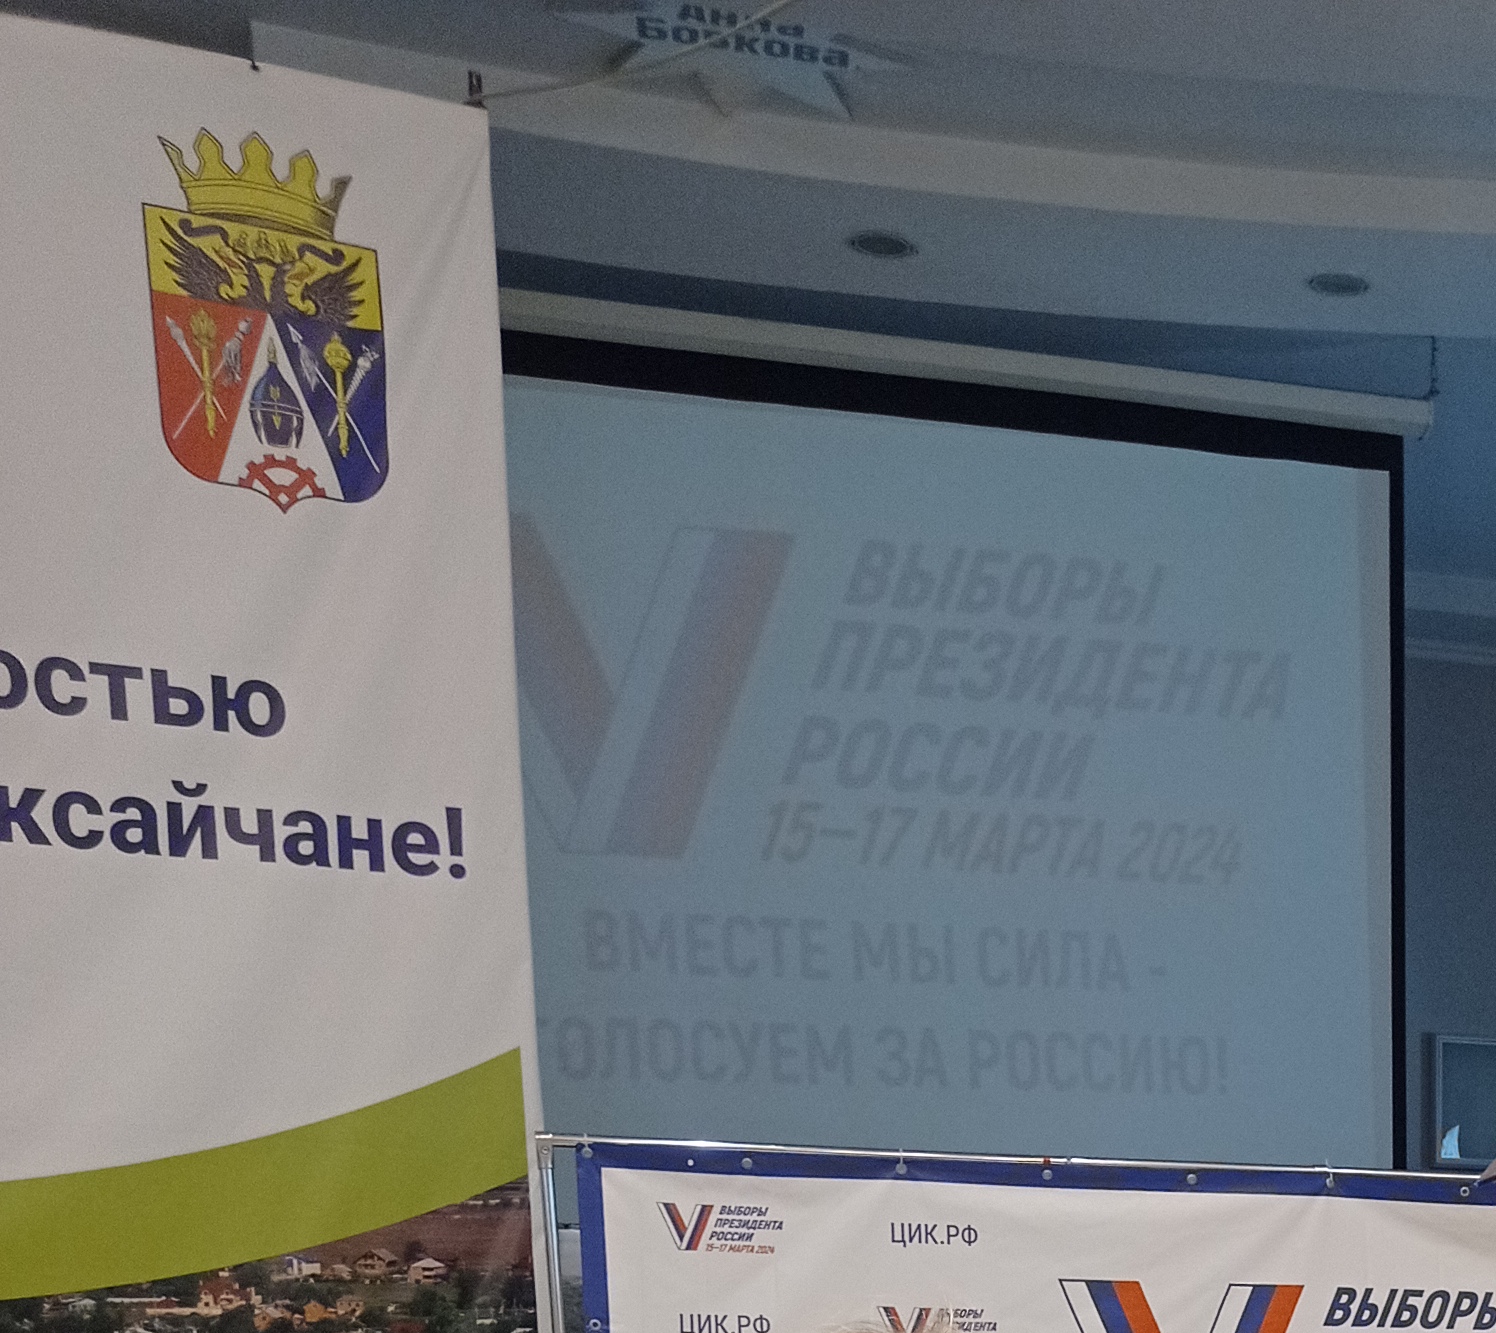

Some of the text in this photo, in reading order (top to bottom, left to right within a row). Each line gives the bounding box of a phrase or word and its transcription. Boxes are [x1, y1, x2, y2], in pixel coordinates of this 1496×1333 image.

[843, 540, 1165, 627] ВЫБОРЫ
[811, 620, 1294, 722] ПРЕЗИДЕНТА
[782, 716, 1096, 801] РОССИИ
[923, 812, 1106, 878] МАРТА
[1117, 823, 1243, 886] 2024
[582, 909, 831, 982] ВМЕСТЕ
[851, 922, 957, 988] МЫ
[977, 926, 1129, 991] СИЛА
[875, 1026, 948, 1090] ЗА
[968, 1030, 1230, 1095] РОССИЮ!
[709, 1231, 754, 1242] РОССИИ
[714, 1218, 783, 1230] ПРЕЗИДЕНТА
[719, 1205, 769, 1216] ВЫБОРЫ
[890, 1222, 978, 1248] ЦИК.РФ
